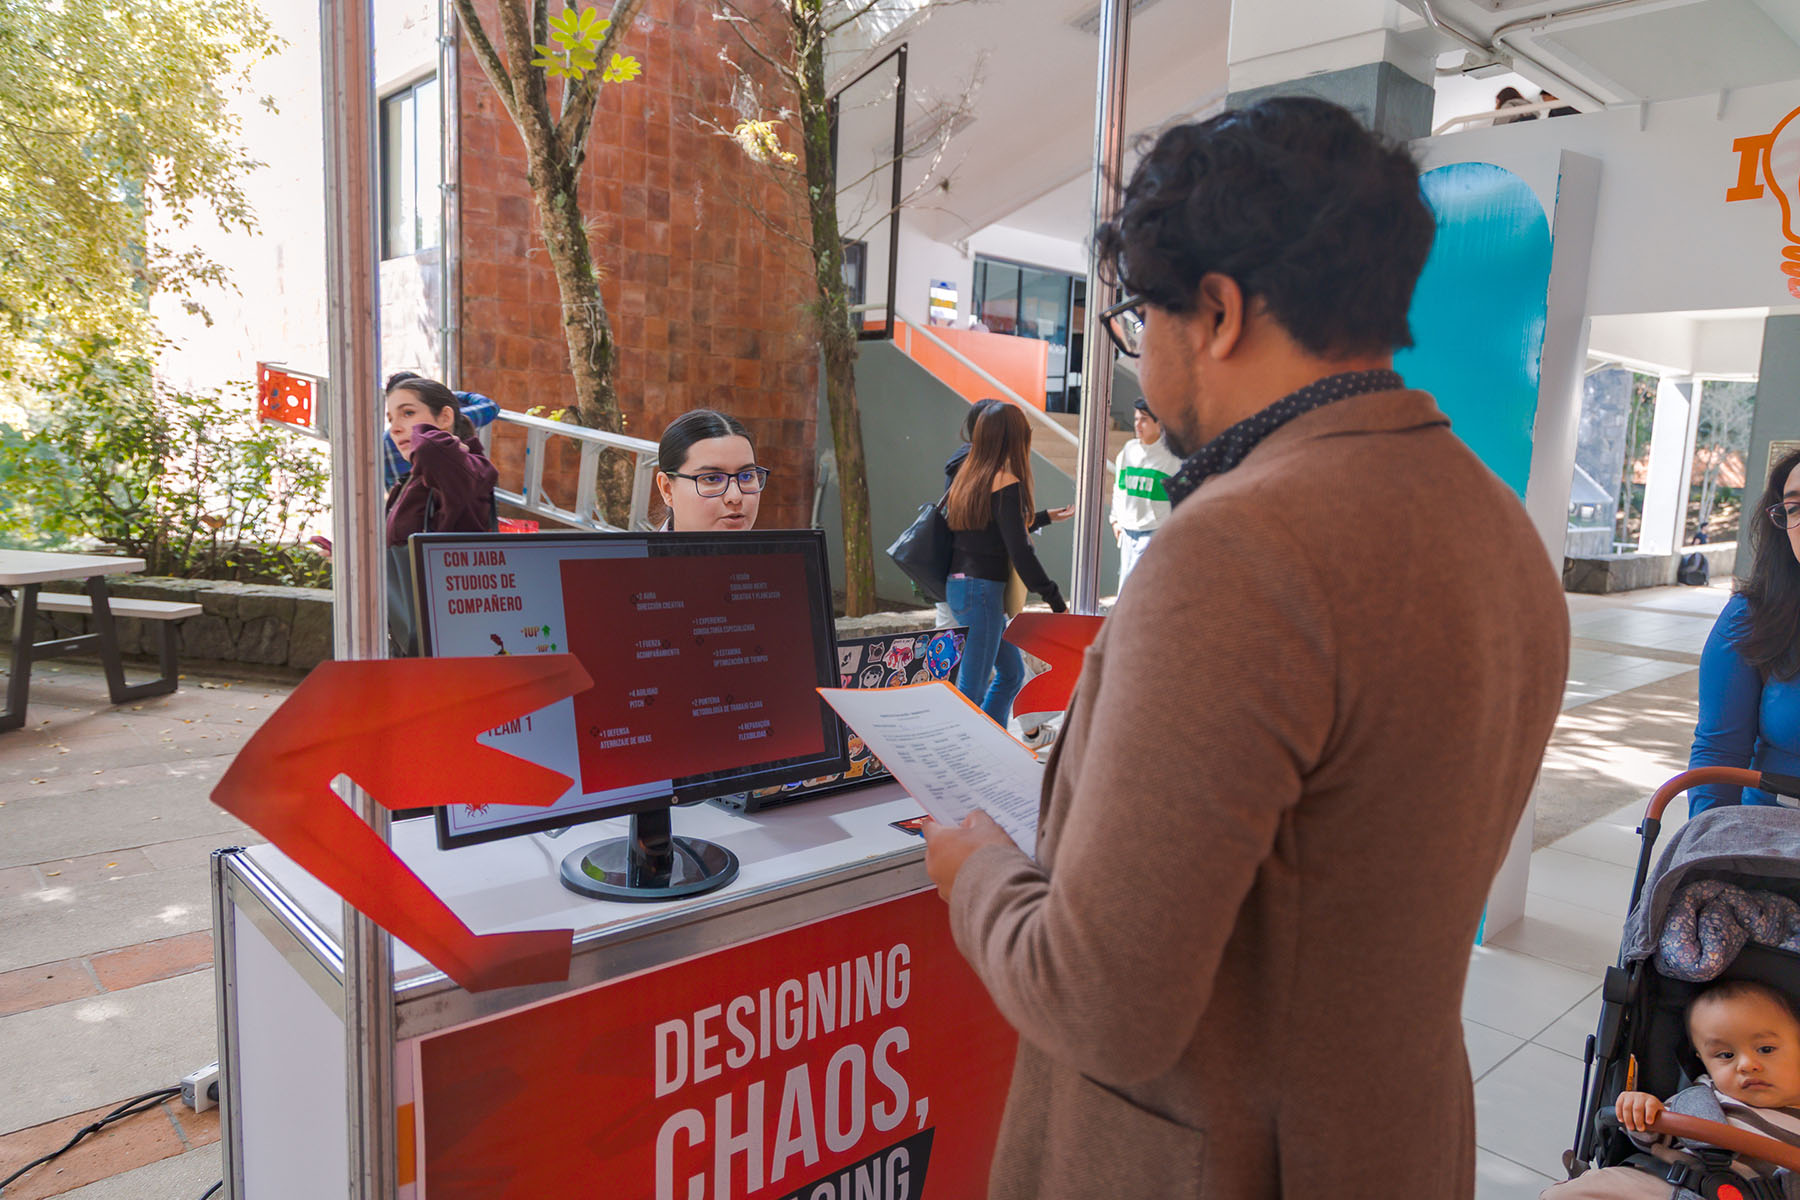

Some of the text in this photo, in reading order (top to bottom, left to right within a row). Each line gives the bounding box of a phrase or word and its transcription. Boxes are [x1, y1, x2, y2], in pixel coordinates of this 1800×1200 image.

[443, 550, 506, 568] CON JAIBA
[446, 573, 516, 591] STUDIOS DE
[448, 594, 523, 615] COMPAÑERO
[642, 640, 661, 648] FUERZA
[629, 699, 645, 709] PITCH
[525, 716, 532, 732] 1
[607, 727, 630, 737] DEFENSA
[600, 734, 652, 749] ATERRIZAJE DE IDEAS
[655, 943, 912, 1099] DESIGNING
[655, 1026, 929, 1200] CHAOS,
